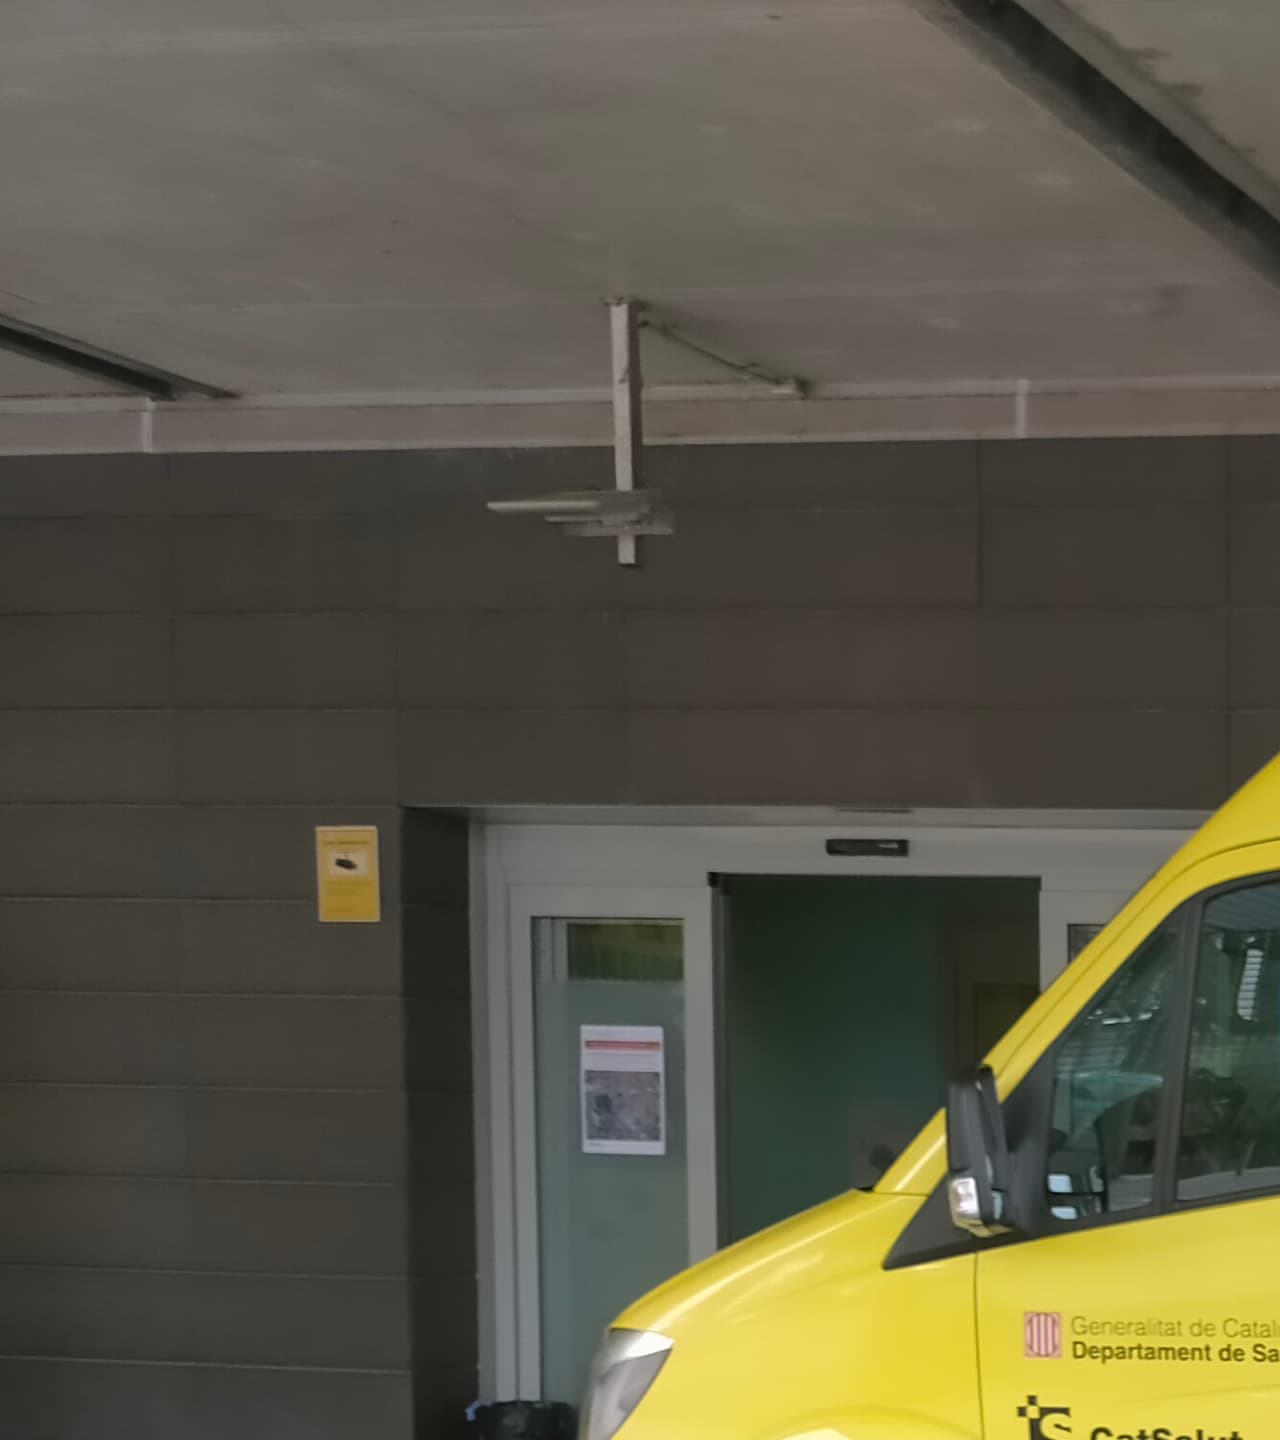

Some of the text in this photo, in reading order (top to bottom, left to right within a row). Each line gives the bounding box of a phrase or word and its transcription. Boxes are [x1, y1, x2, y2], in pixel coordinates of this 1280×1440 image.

[1071, 1316, 1182, 1338] Generalitat
[1189, 1319, 1216, 1338] de
[1071, 1341, 1212, 1364] Departament
[1218, 1345, 1245, 1362] de
